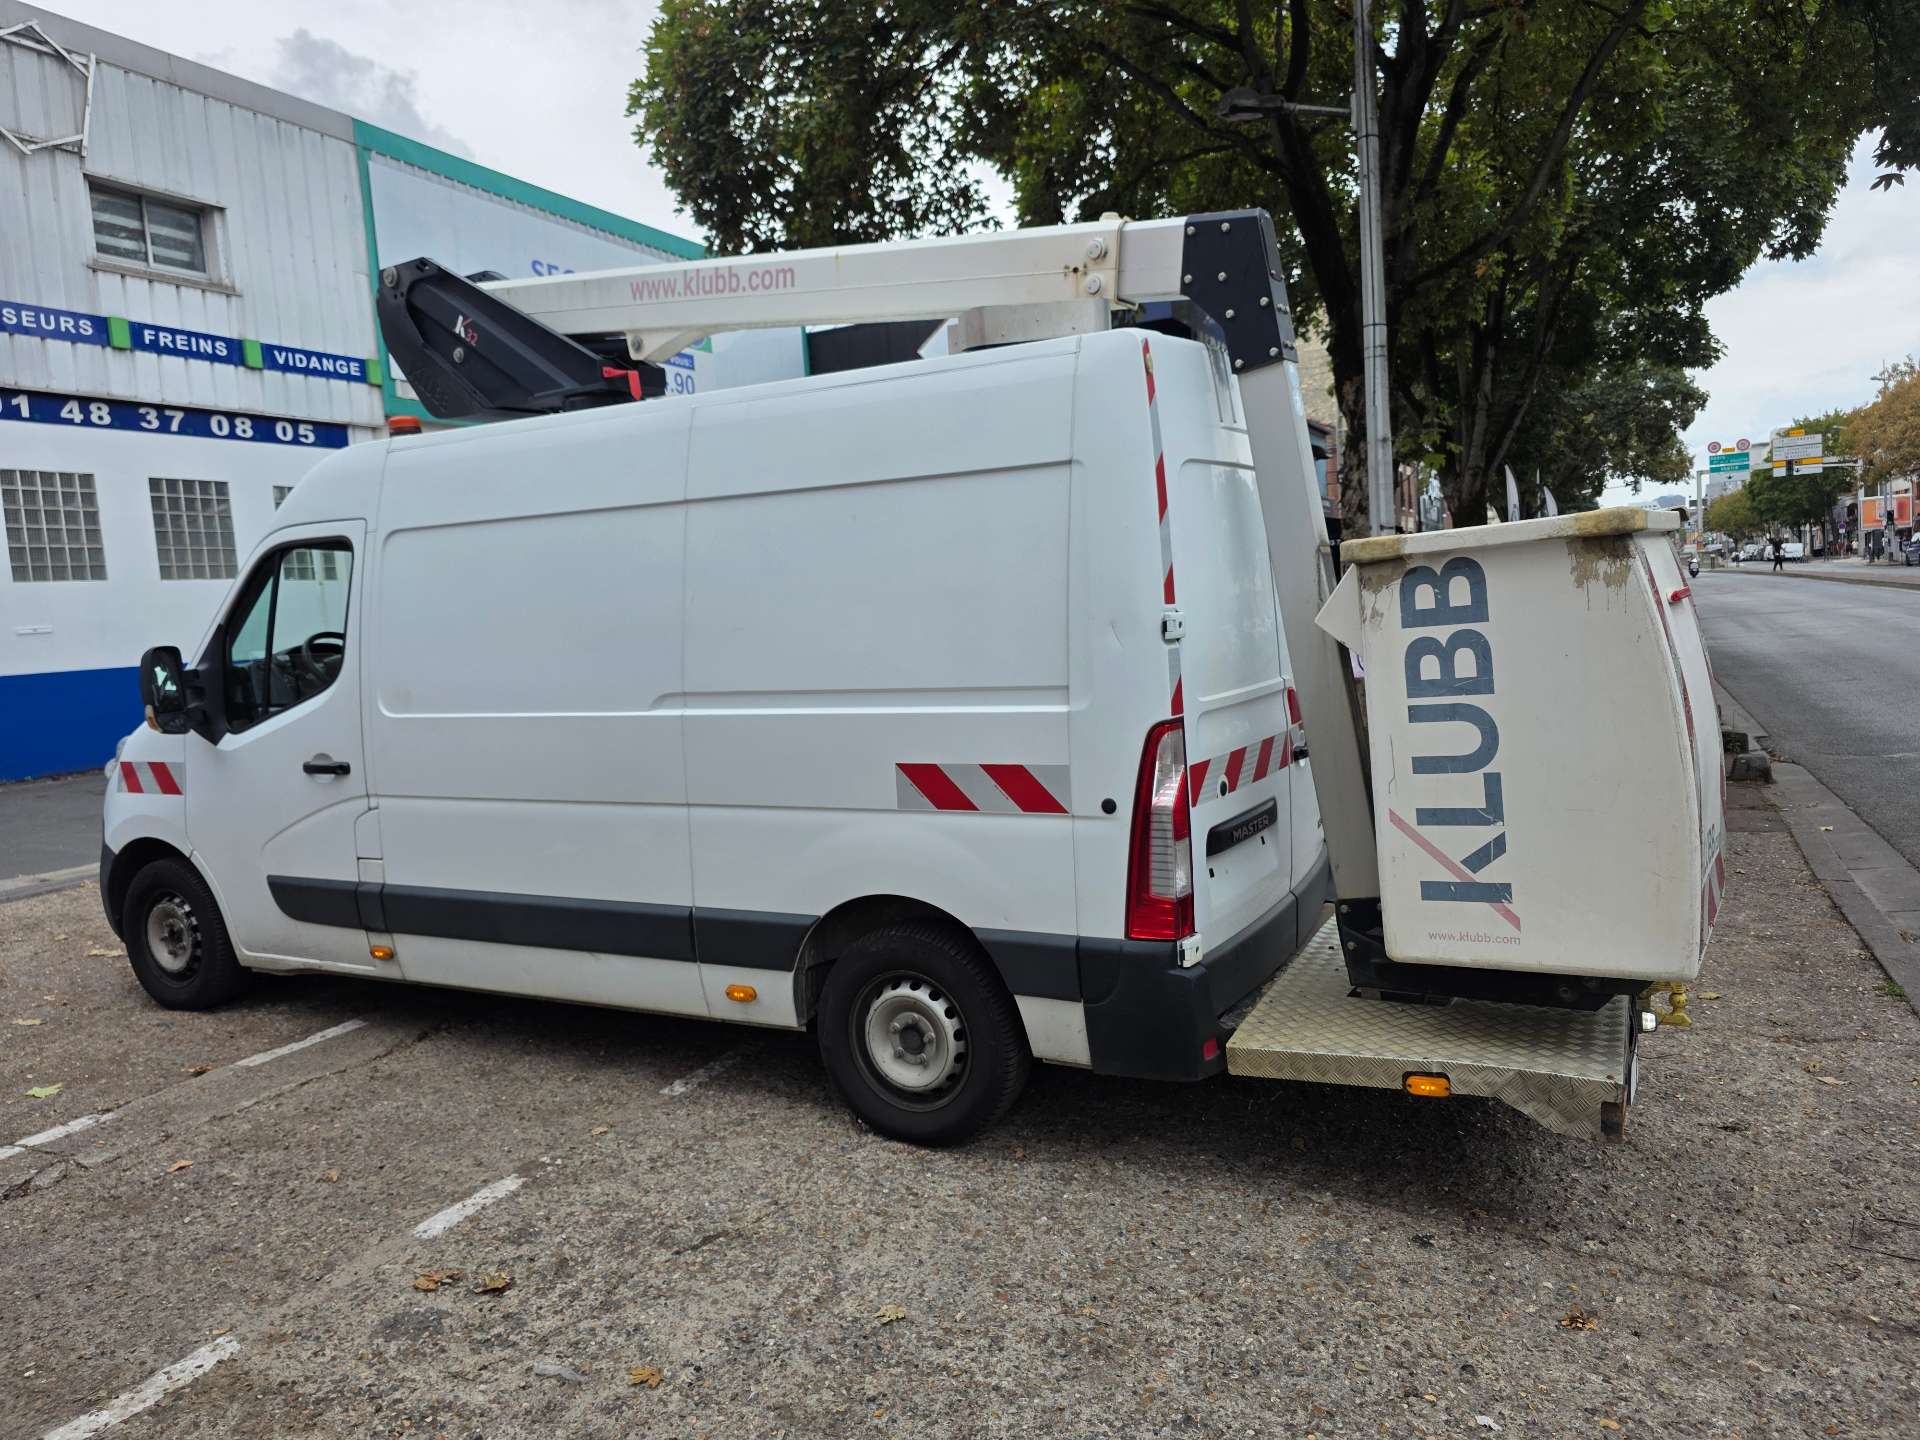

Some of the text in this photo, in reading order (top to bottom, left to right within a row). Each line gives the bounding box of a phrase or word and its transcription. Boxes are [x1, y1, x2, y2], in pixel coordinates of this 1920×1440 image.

[631, 264, 796, 301] www.klubb.com
[2, 308, 94, 336] SEURS
[144, 329, 228, 356] FREINS
[273, 350, 362, 377] VIDANGE
[0, 394, 317, 445] 1 48 37 08 05
[1390, 557, 1520, 930] KLUBB
[1232, 815, 1269, 841] MASTER
[1428, 930, 1521, 946] www.klubb.com
